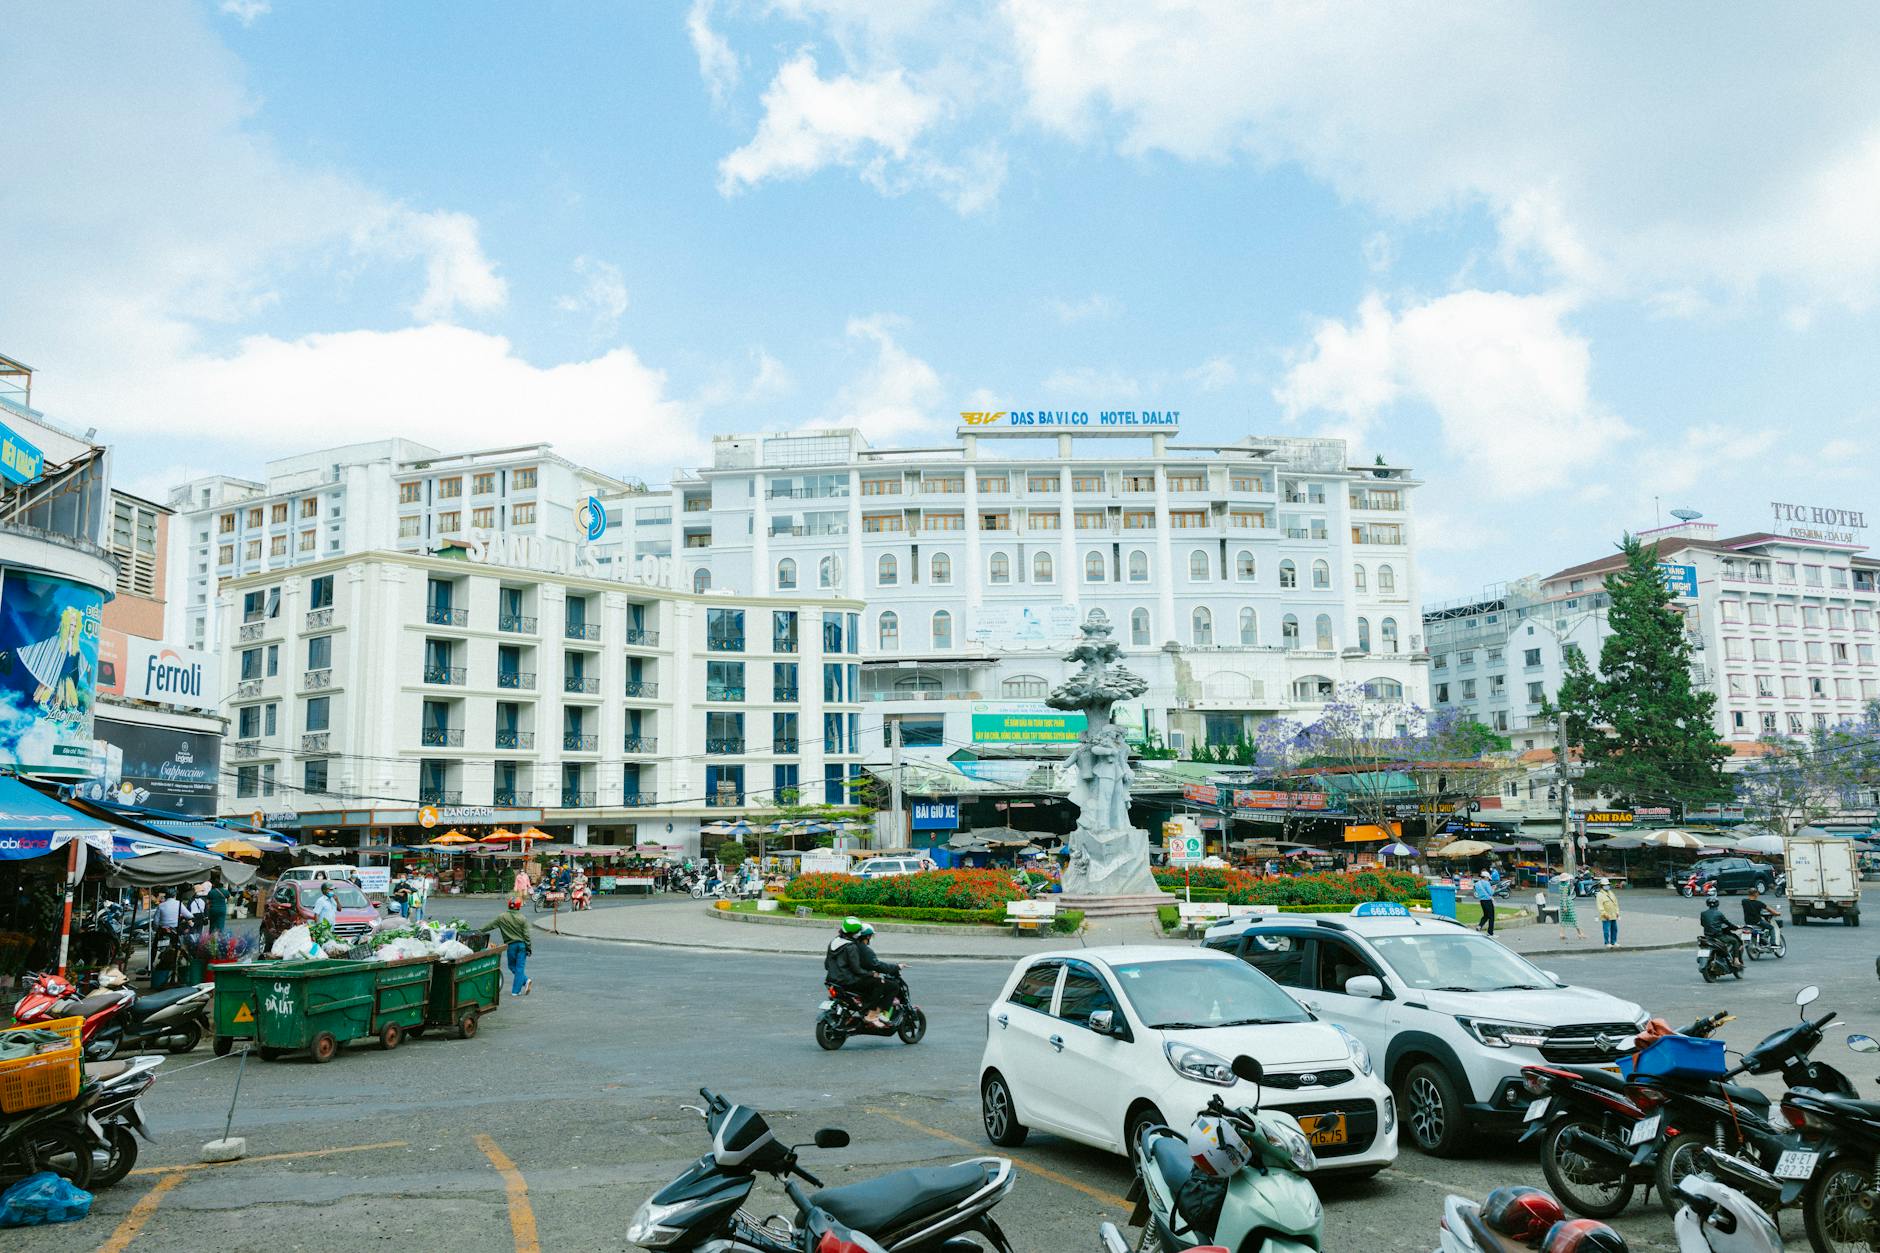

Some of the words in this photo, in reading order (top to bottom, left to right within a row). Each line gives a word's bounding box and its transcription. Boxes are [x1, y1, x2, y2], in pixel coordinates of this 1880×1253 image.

[1010, 411, 1034, 425] DAS
[1100, 411, 1139, 425] HOTEL
[1142, 411, 1180, 425] DALAT
[1770, 502, 1806, 522] TTC
[1811, 506, 1869, 528] HOTEL
[160, 760, 205, 781] Cappuccino
[945, 804, 956, 818] XE
[1586, 813, 1610, 822] ANH
[0, 837, 49, 849] obifone
[1301, 1074, 1316, 1083] KIA
